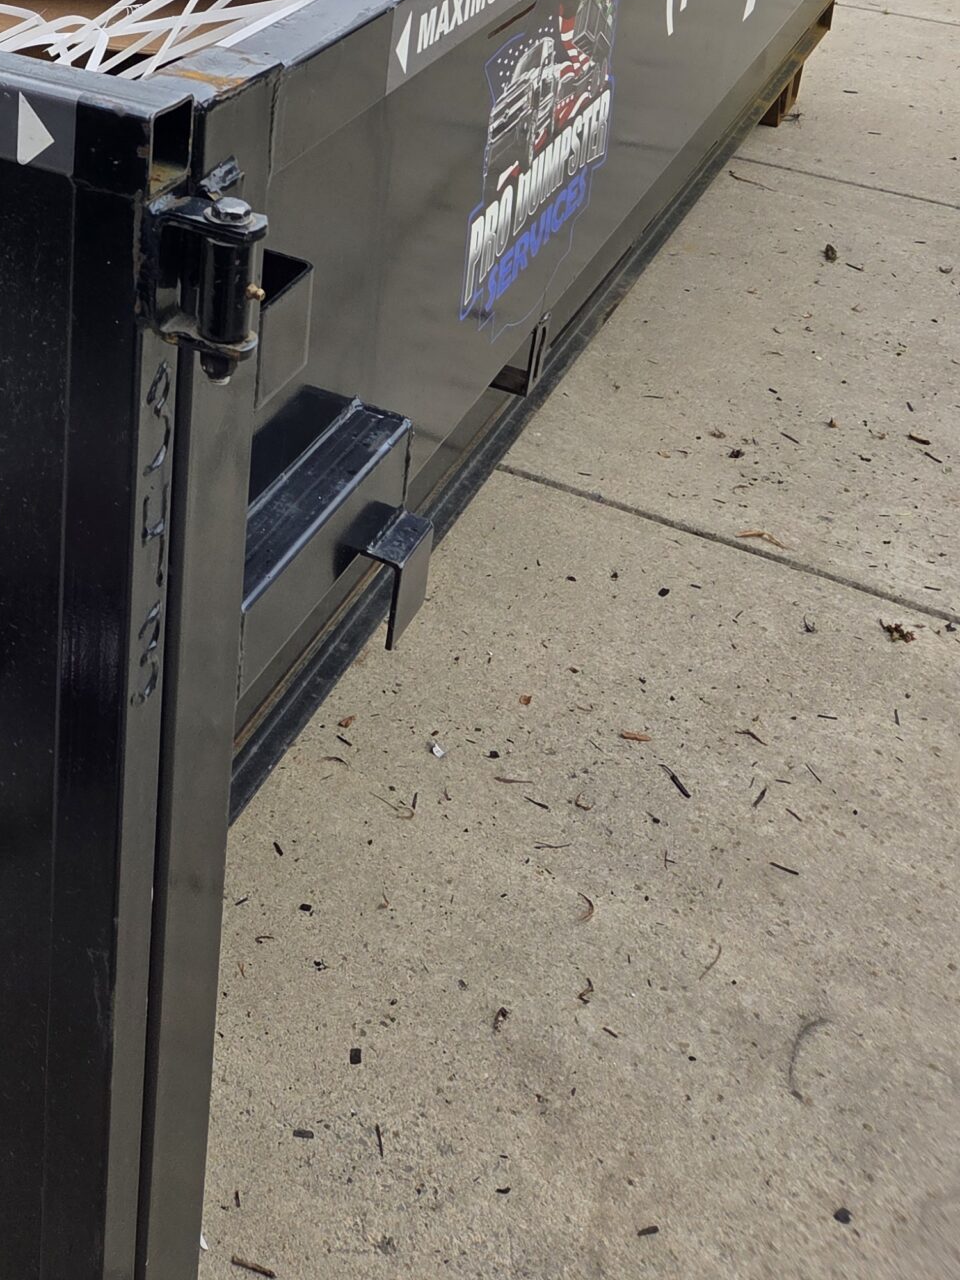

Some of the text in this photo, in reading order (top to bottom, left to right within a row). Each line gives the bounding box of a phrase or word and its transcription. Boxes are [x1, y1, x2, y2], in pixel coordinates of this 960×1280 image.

[464, 89, 611, 306] PRO DUMPSTER
[485, 170, 588, 311] SERVICES
